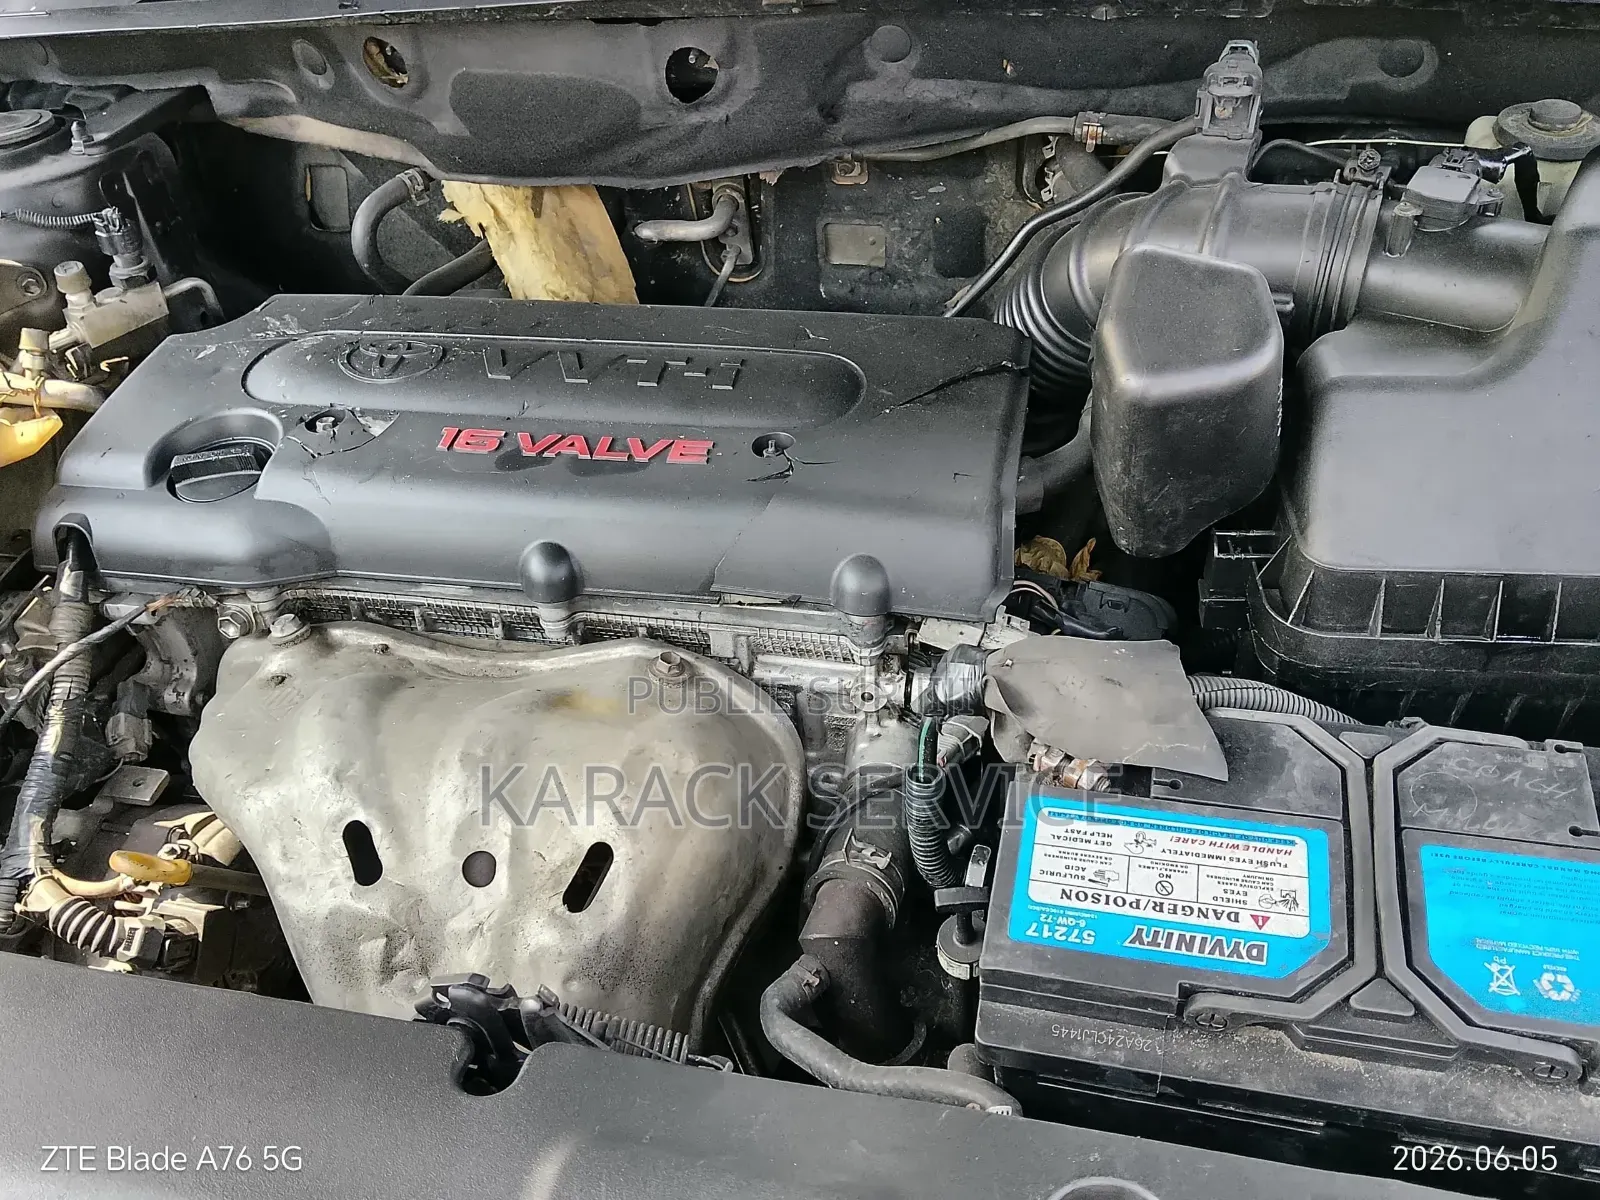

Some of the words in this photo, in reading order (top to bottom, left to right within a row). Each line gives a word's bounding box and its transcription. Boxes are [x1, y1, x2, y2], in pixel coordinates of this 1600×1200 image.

[437, 427, 507, 454] 16
[517, 432, 715, 465] VALVE
[1050, 834, 1091, 844] MEDICAL
[1170, 836, 1205, 846] CARE!
[1208, 840, 1240, 851] WITH
[1242, 844, 1292, 856] HANDLE
[1161, 848, 1226, 861] IMMEDIATELY
[1229, 856, 1254, 864] EYES
[1256, 860, 1288, 868] FLUSH
[1039, 869, 1086, 880] SULFURIC
[1223, 888, 1248, 896] EYES
[1060, 888, 1240, 923] DANGER/POISON
[1212, 896, 1248, 906] SHIELD
[1039, 914, 1087, 928] 6-QW-72
[1025, 922, 1096, 945] 57217
[1123, 924, 1268, 965] DYVINITY
[1493, 955, 1507, 964] Pb
